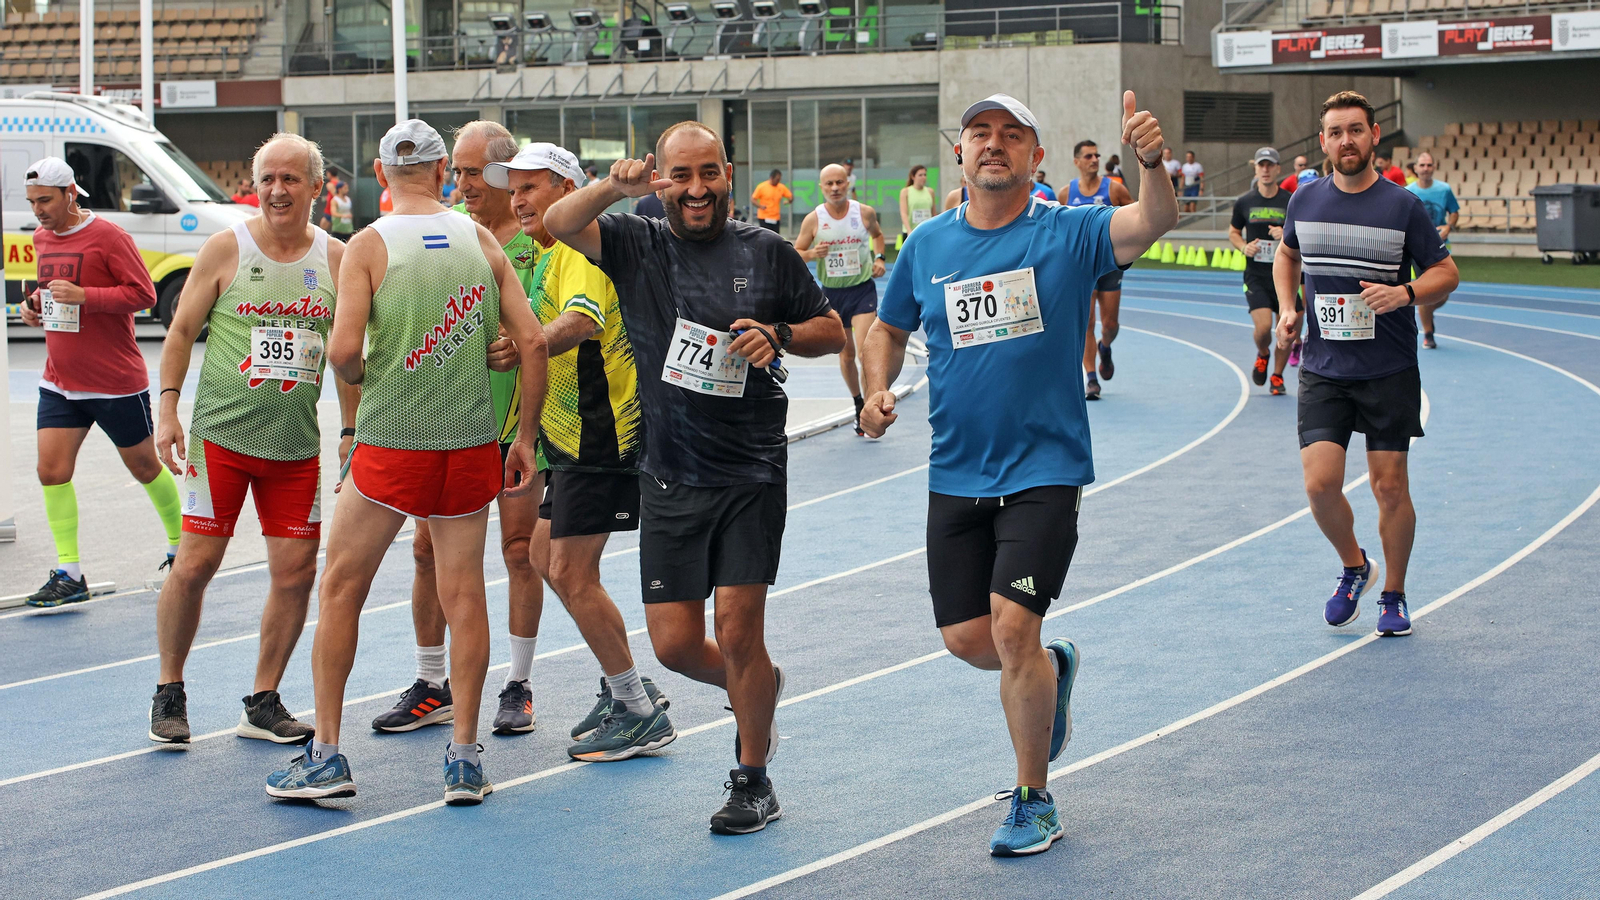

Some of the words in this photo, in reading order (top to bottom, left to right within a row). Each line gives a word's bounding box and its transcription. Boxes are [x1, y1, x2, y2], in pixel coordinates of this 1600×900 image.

[1278, 37, 1318, 53] PLAY
[1310, 31, 1366, 59] JEREZ
[1444, 28, 1485, 44] PLAY
[1477, 21, 1534, 51] JEREZ
[829, 258, 845, 268] 230
[236, 295, 331, 319] maratón
[956, 294, 997, 322] 370
[1320, 307, 1344, 323] 391
[258, 319, 316, 331] JEREZ
[405, 284, 487, 371] maratón
[260, 340, 294, 361] 395
[434, 310, 484, 368] JEREZ
[677, 339, 714, 370] 774
[1010, 581, 1037, 596] adidas
